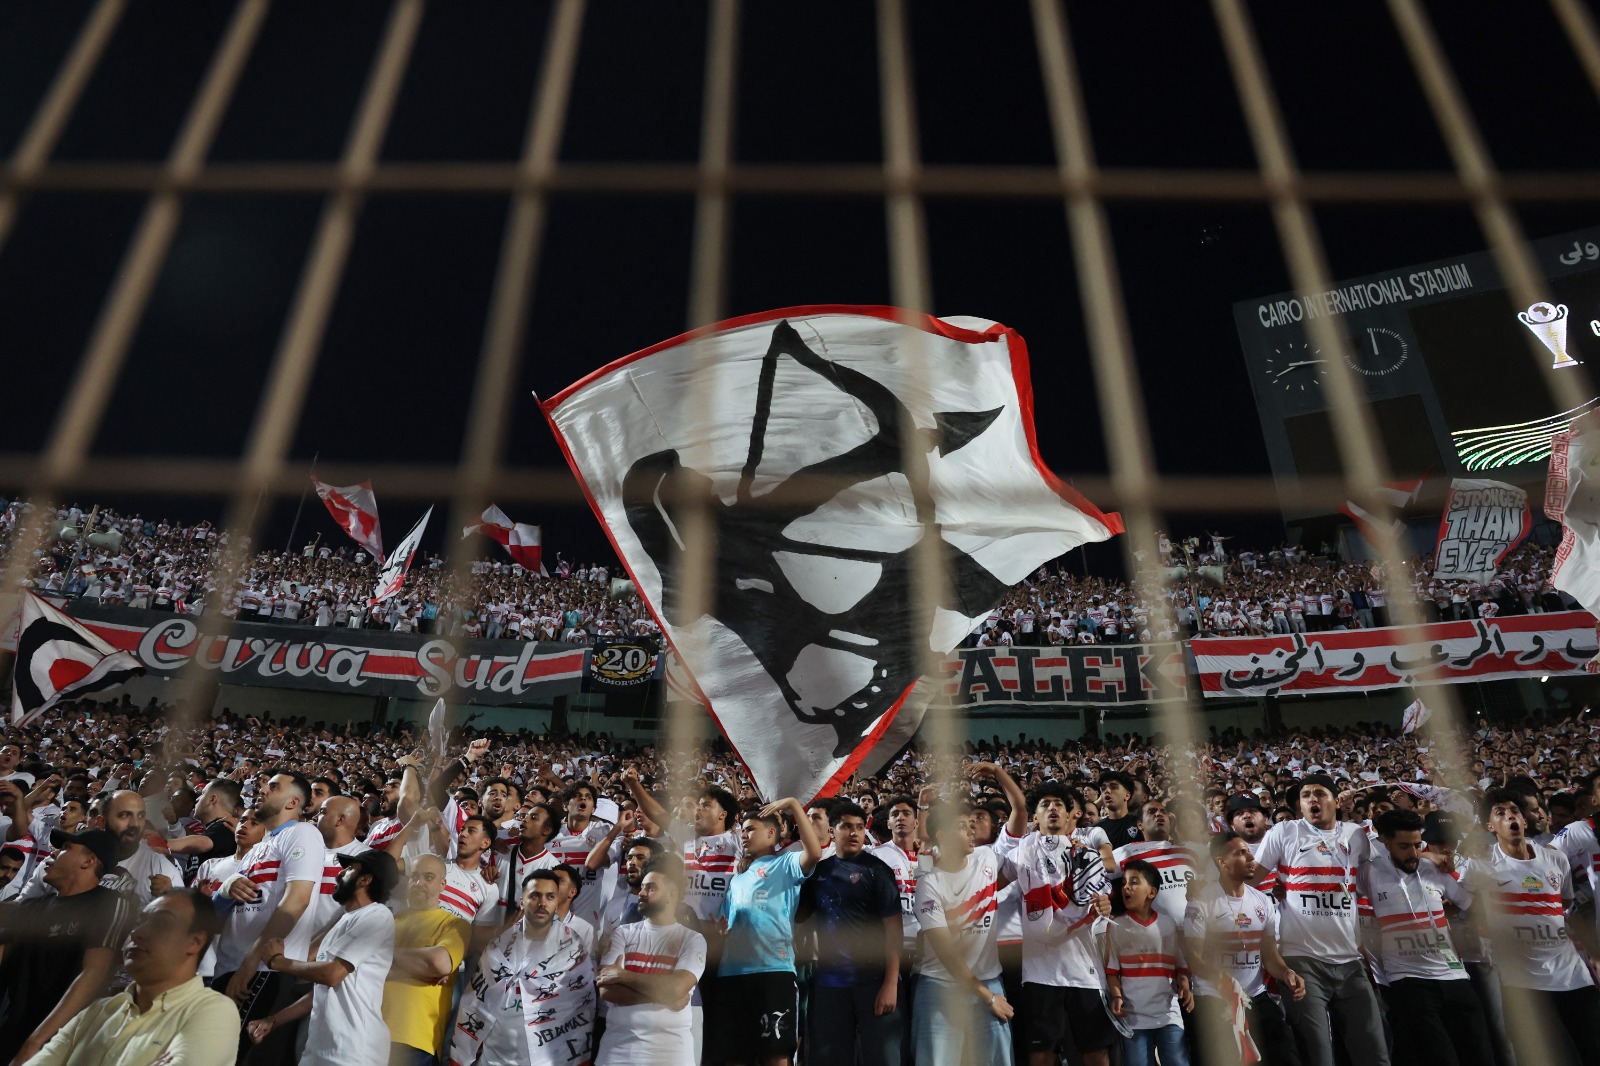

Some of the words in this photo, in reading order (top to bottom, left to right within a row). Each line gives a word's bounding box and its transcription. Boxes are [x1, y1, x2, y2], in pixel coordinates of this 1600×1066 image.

[1258, 299, 1303, 328] CAIRO
[1303, 276, 1413, 320] INTERNATIONAL
[1409, 263, 1473, 298] STADIUM
[1451, 487, 1526, 511] STRONGER
[1447, 506, 1523, 542] THAN
[1435, 538, 1509, 573] EVER
[139, 619, 367, 687] Curva
[416, 640, 538, 697] Sud
[601, 648, 647, 671] 20
[945, 647, 1187, 702] ALEK
